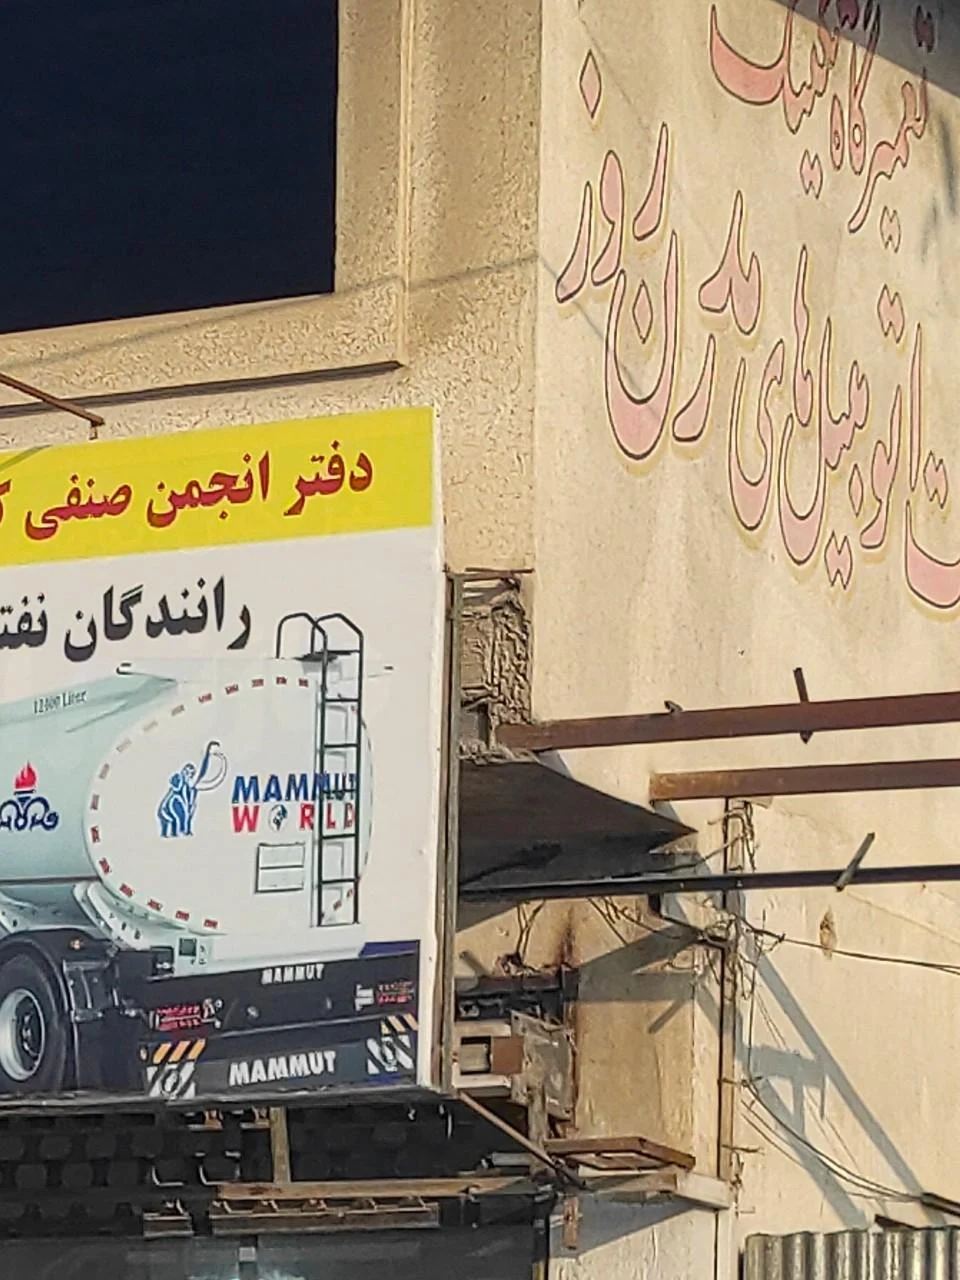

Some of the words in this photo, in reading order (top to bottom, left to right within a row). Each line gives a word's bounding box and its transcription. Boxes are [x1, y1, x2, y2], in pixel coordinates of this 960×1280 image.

[25, 472, 133, 541] صنفی
[146, 450, 271, 528] انجمن
[283, 440, 374, 517] دفتر
[63, 574, 252, 662] رانندگان
[261, 963, 325, 985] MAMMUT
[228, 1050, 337, 1087] MAMMUT
